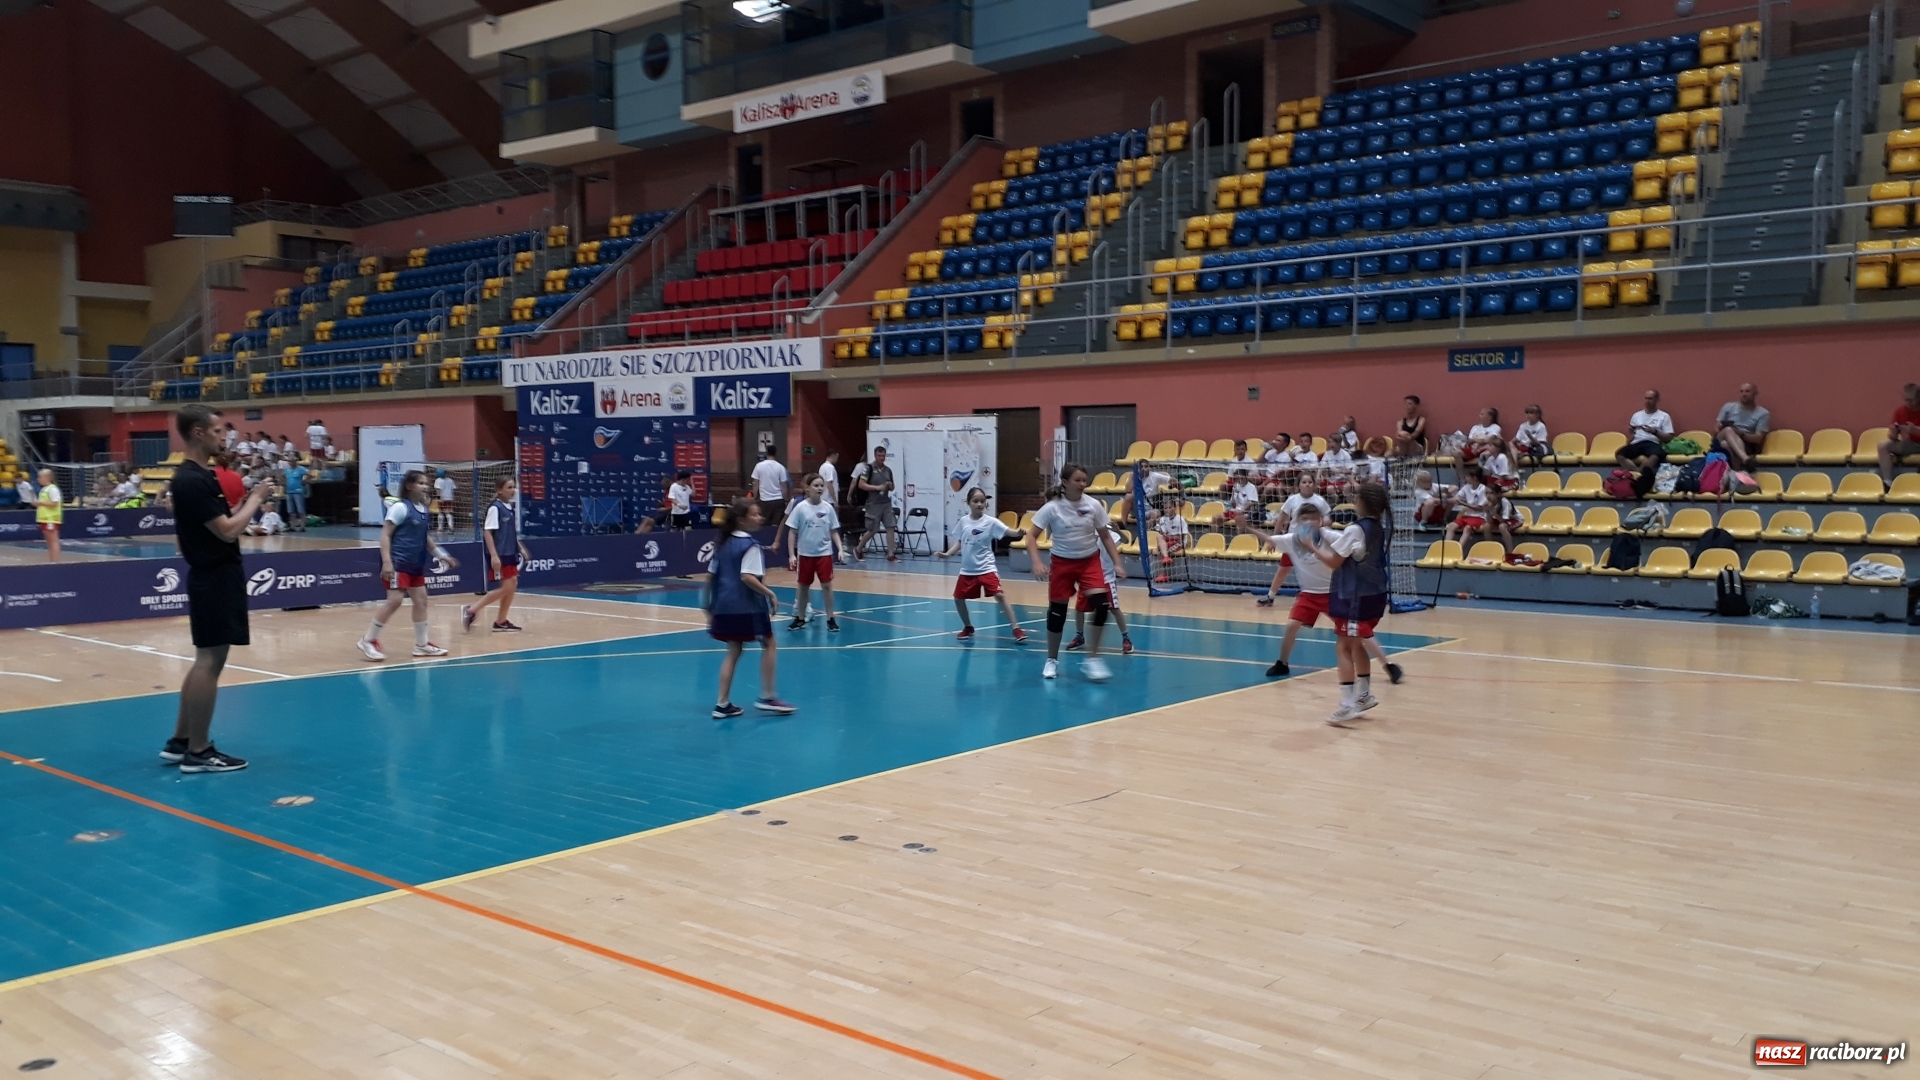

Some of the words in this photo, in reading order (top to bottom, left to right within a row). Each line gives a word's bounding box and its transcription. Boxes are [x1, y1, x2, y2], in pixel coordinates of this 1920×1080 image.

[740, 102, 782, 124] Kalisz
[796, 91, 841, 112] Arena
[510, 362, 531, 383] TU
[535, 356, 615, 381] NARODZIŁ
[652, 343, 803, 375] SZCZYPIORNIAK
[1453, 352, 1505, 367] SEKTOR
[1511, 351, 1519, 364] J
[530, 389, 581, 416] Kalisz
[620, 389, 662, 408] Arena
[710, 380, 773, 411] Kalisz
[525, 558, 555, 572] ZPRP
[277, 574, 317, 590] ZPRP
